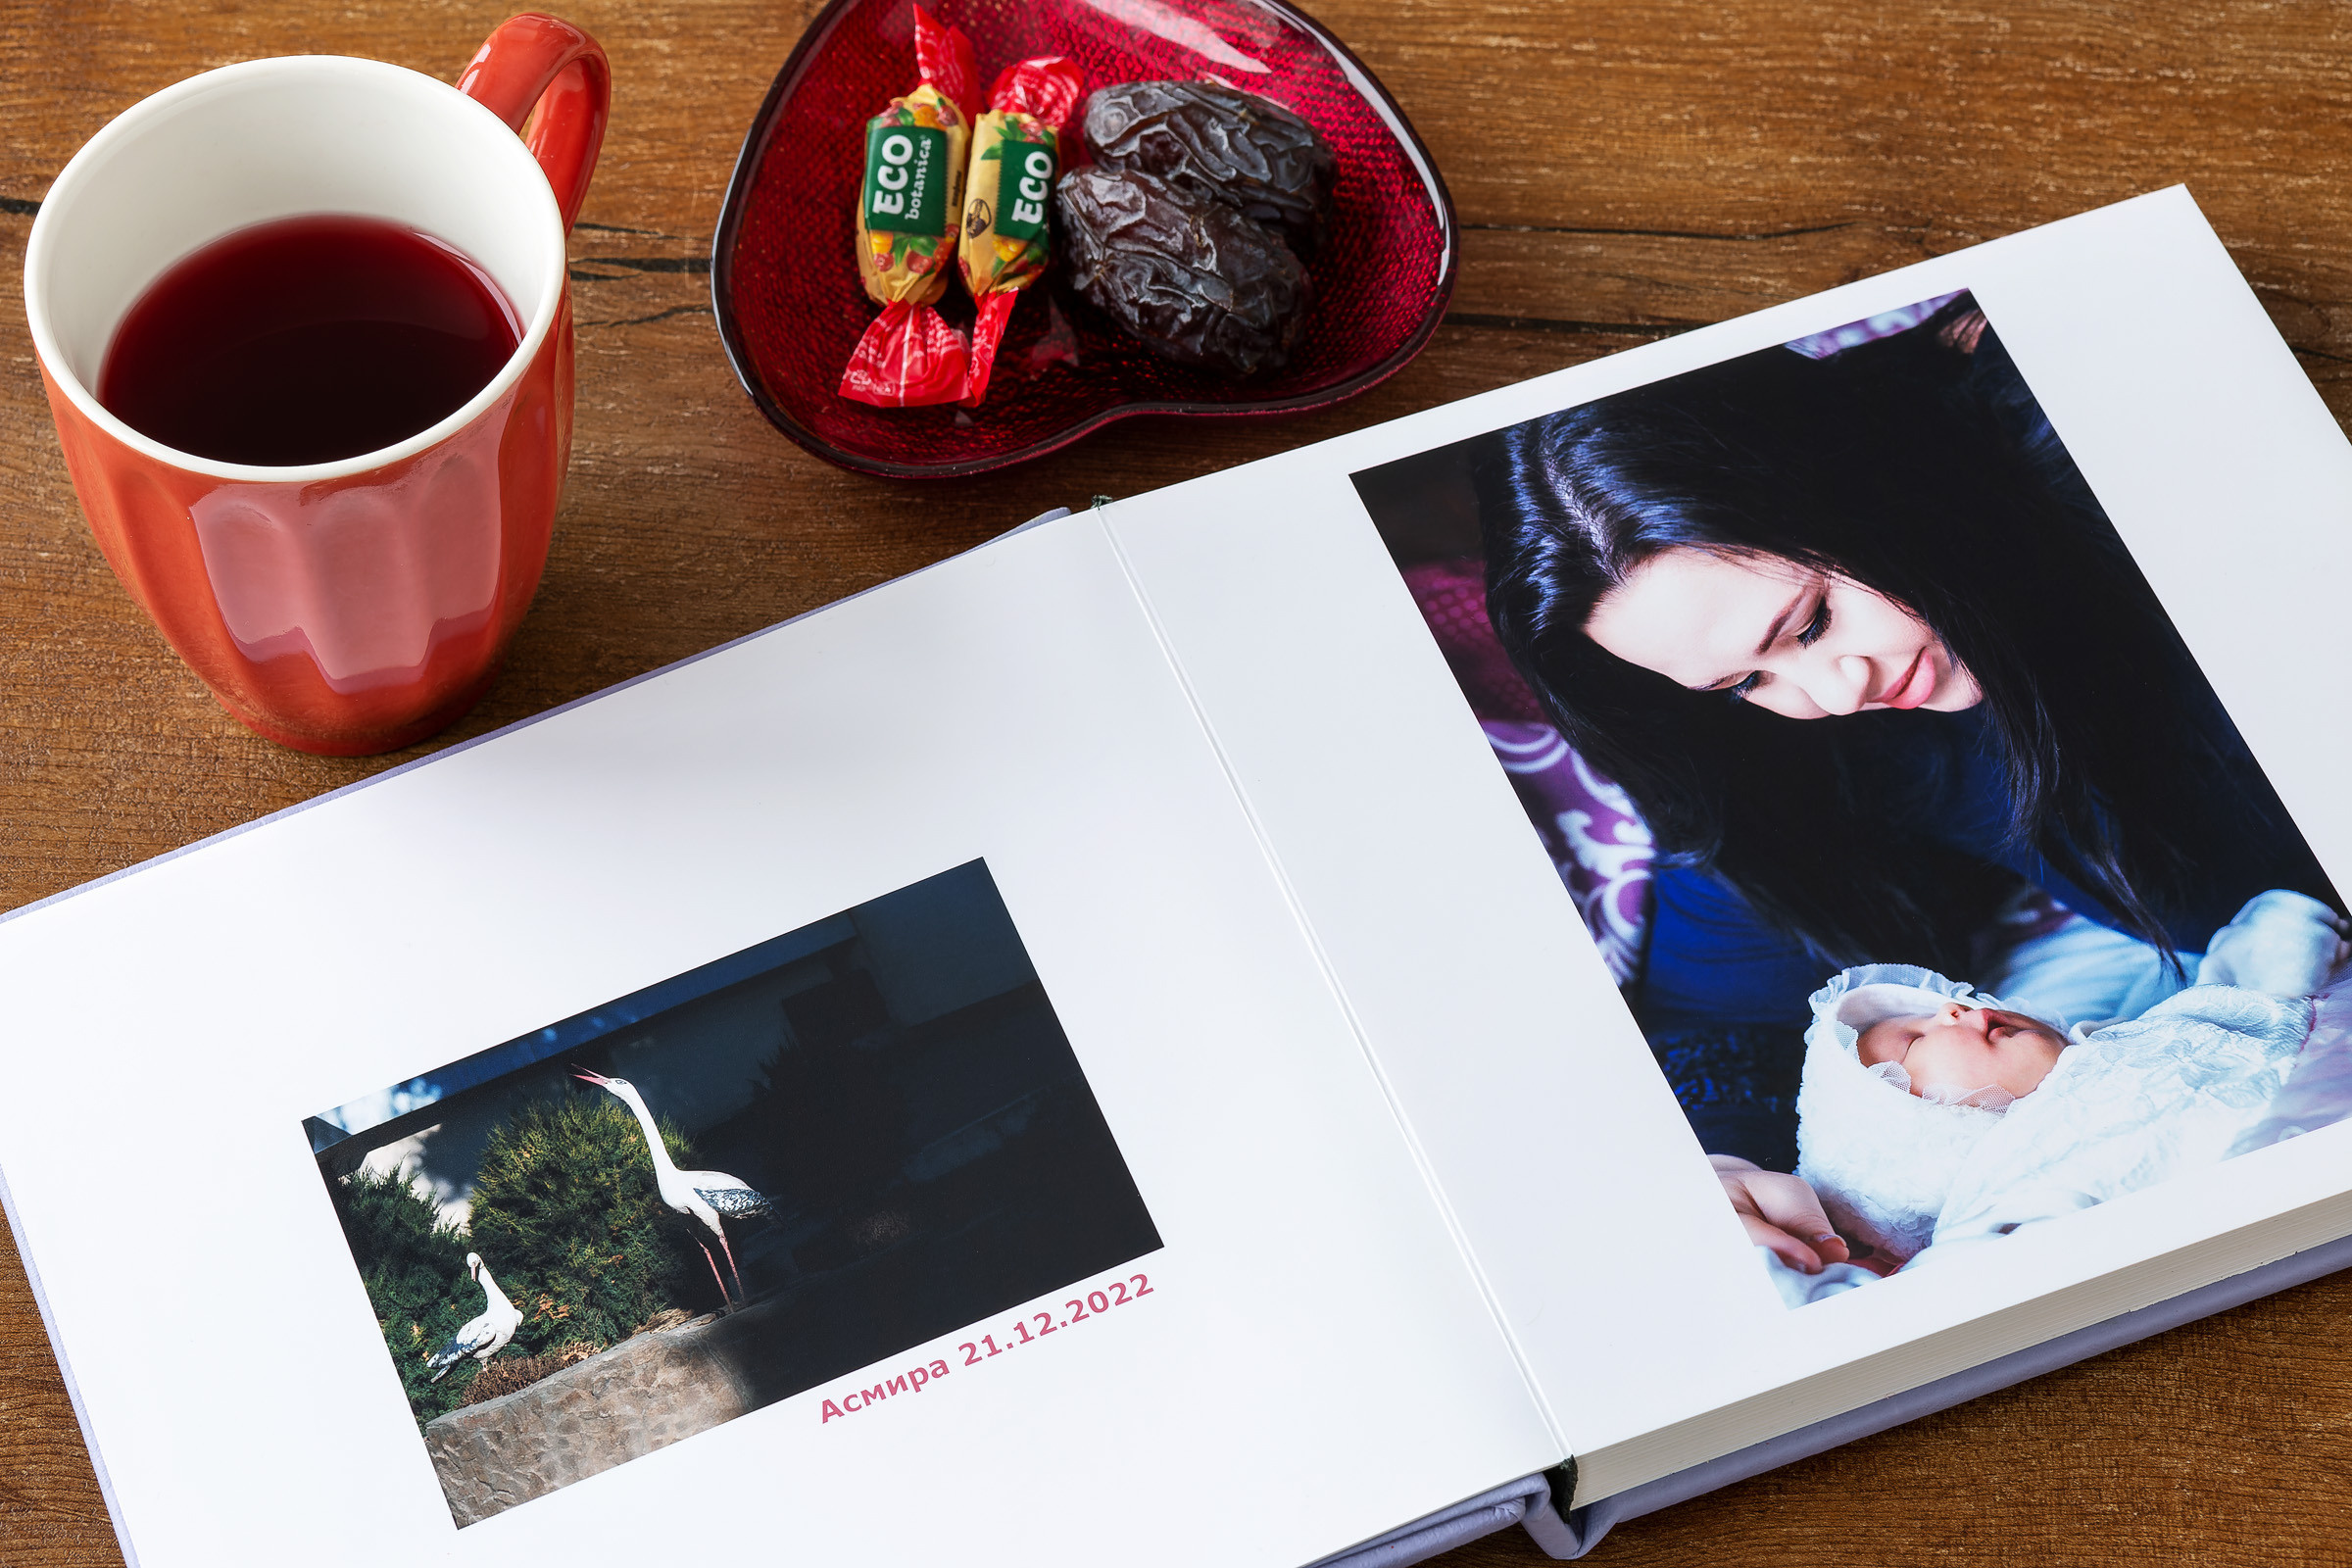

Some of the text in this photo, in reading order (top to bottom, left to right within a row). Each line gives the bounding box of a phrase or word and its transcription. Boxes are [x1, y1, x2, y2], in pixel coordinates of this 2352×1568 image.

[872, 134, 914, 216] ECO
[905, 137, 933, 220] botanica
[1011, 151, 1054, 225] ECO
[821, 1273, 1154, 1424] Асмира 21.12.2022
